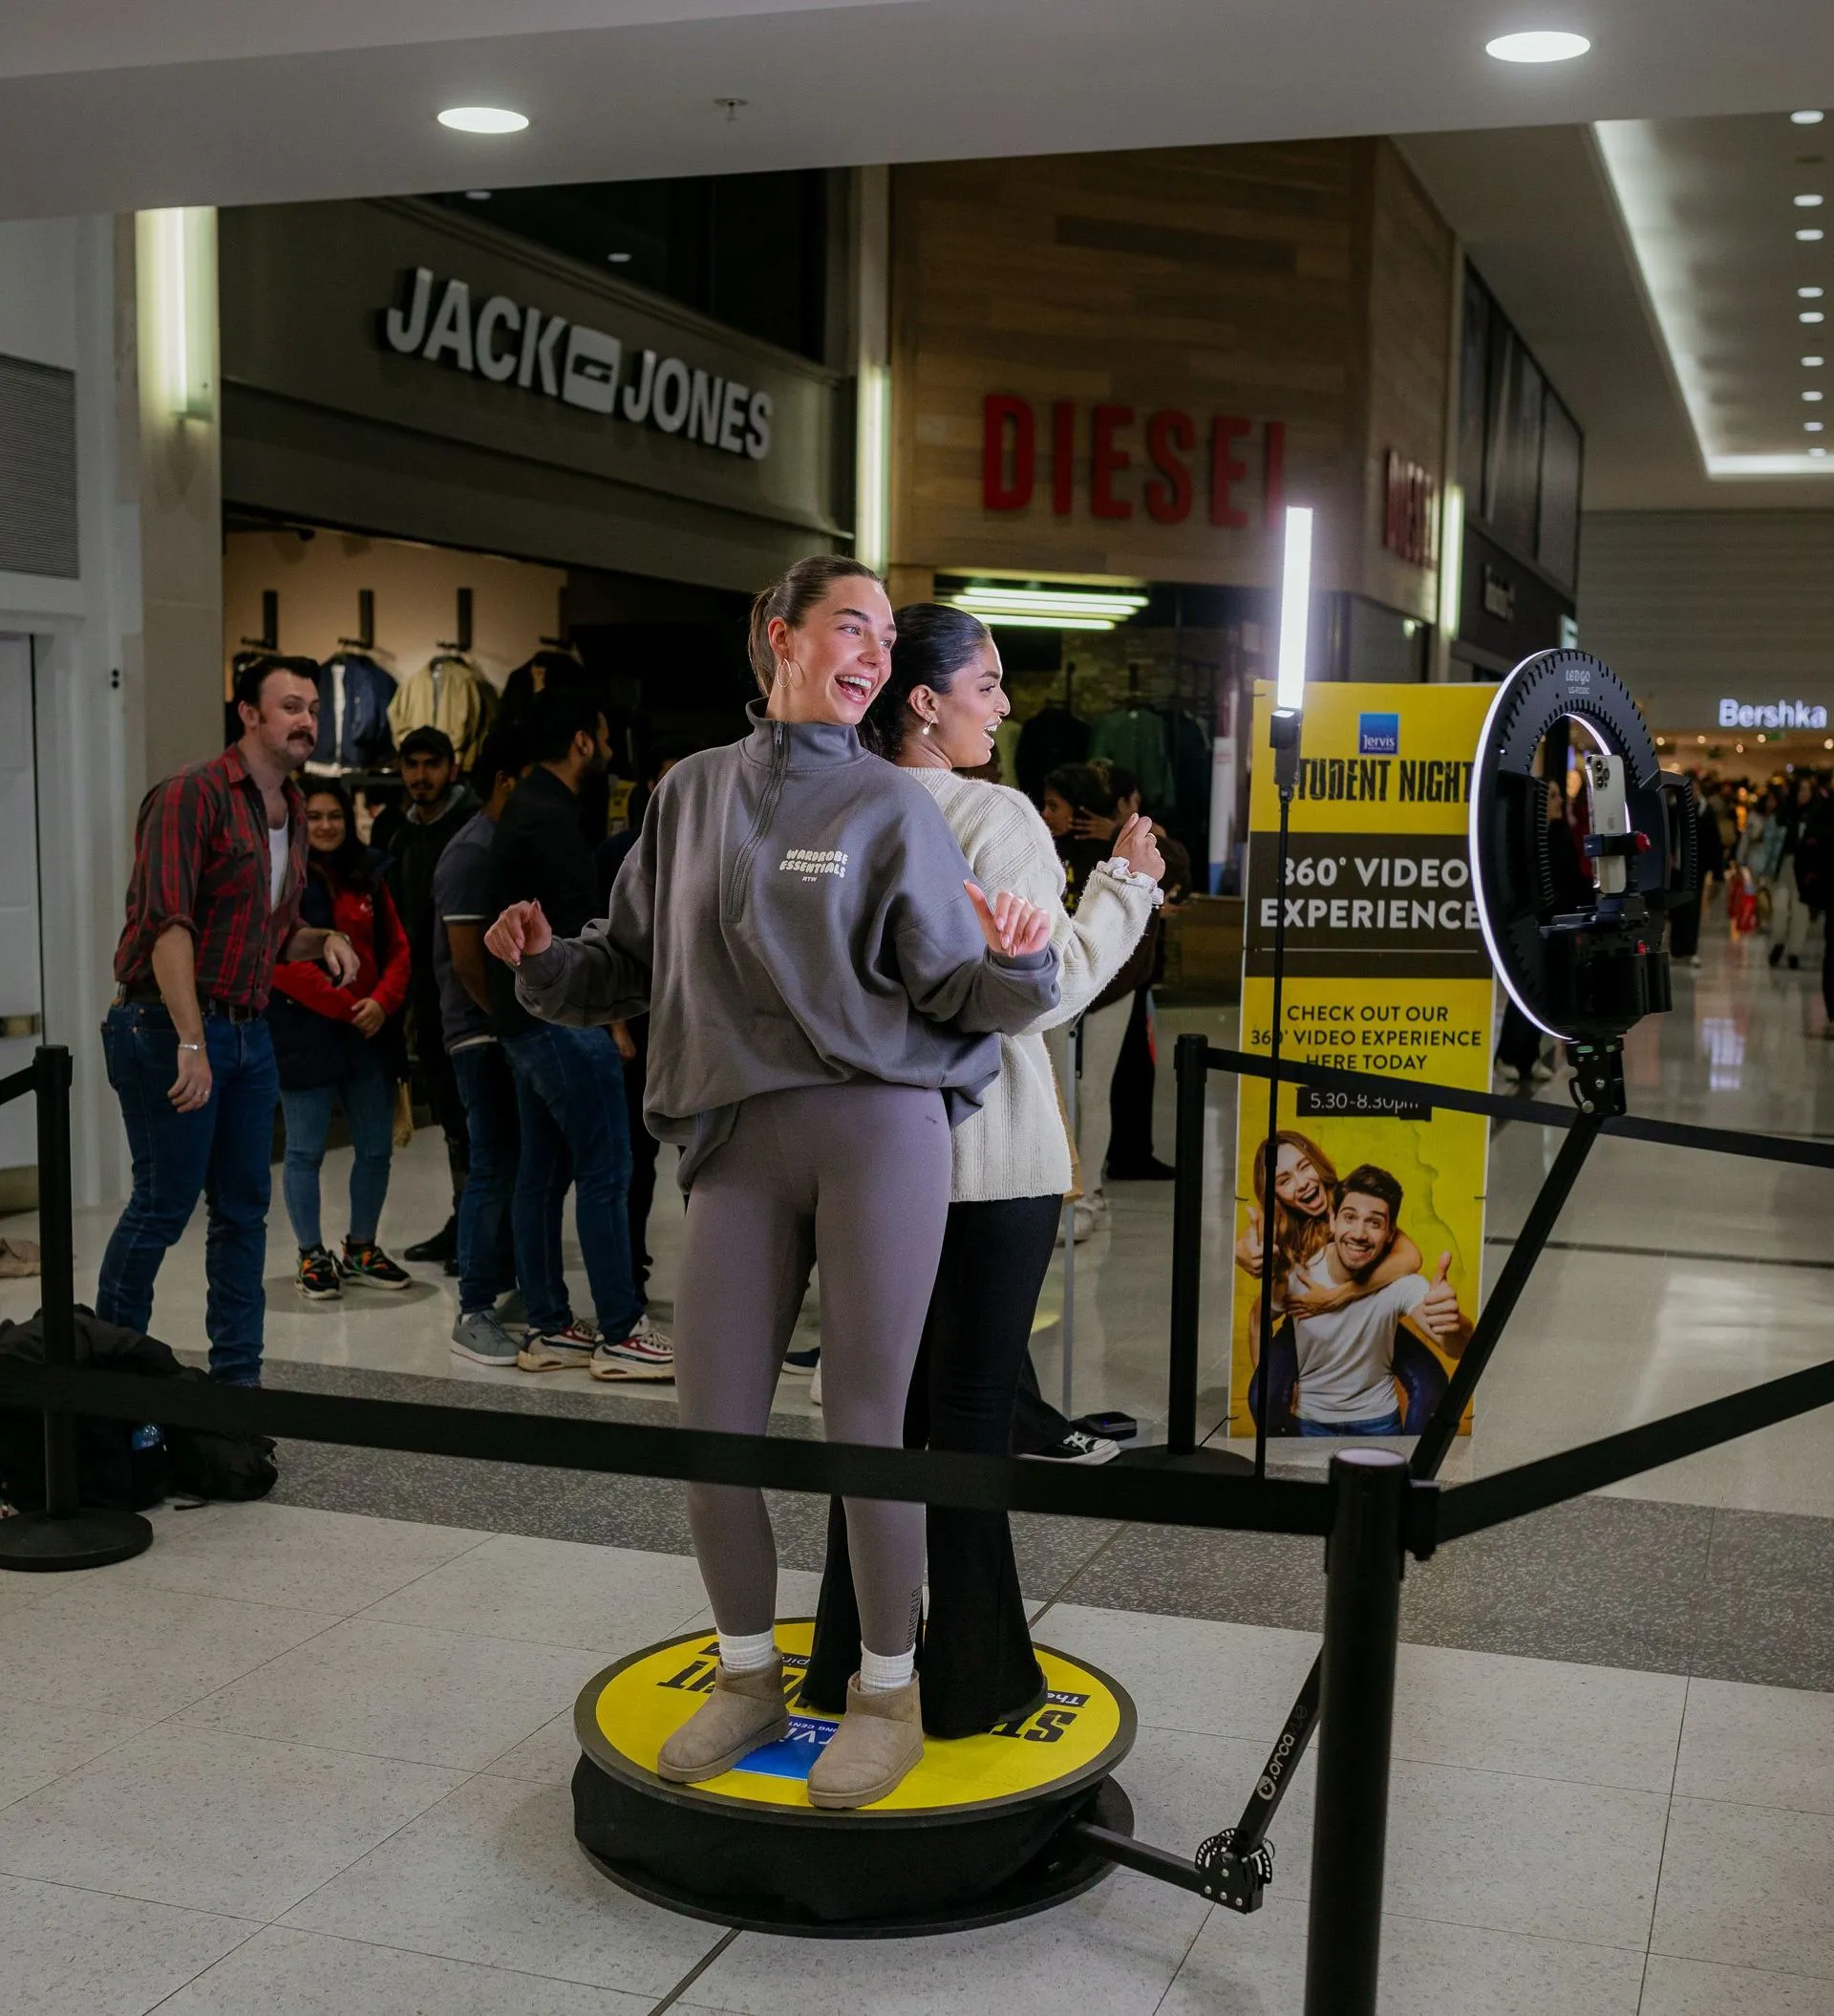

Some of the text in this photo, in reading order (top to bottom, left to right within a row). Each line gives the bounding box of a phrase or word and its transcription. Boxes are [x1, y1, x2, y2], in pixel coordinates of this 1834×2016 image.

[387, 267, 774, 460] JACK JONES
[1718, 697, 1828, 728] Bershka
[1362, 734, 1397, 750] Jervis
[1298, 758, 1477, 804] TUDENT NIGHT
[786, 848, 849, 866] WARDROBE
[779, 860, 846, 879] ESSENTIALS
[1354, 857, 1470, 889] VIDEO
[1260, 898, 1483, 931] EXPERIENCE
[1287, 1005, 1449, 1022] CHECK OUT OUR
[1249, 1029, 1482, 1047] 36° VIDEO EXPERIENCE
[1306, 1054, 1429, 1070] HERE TODAY
